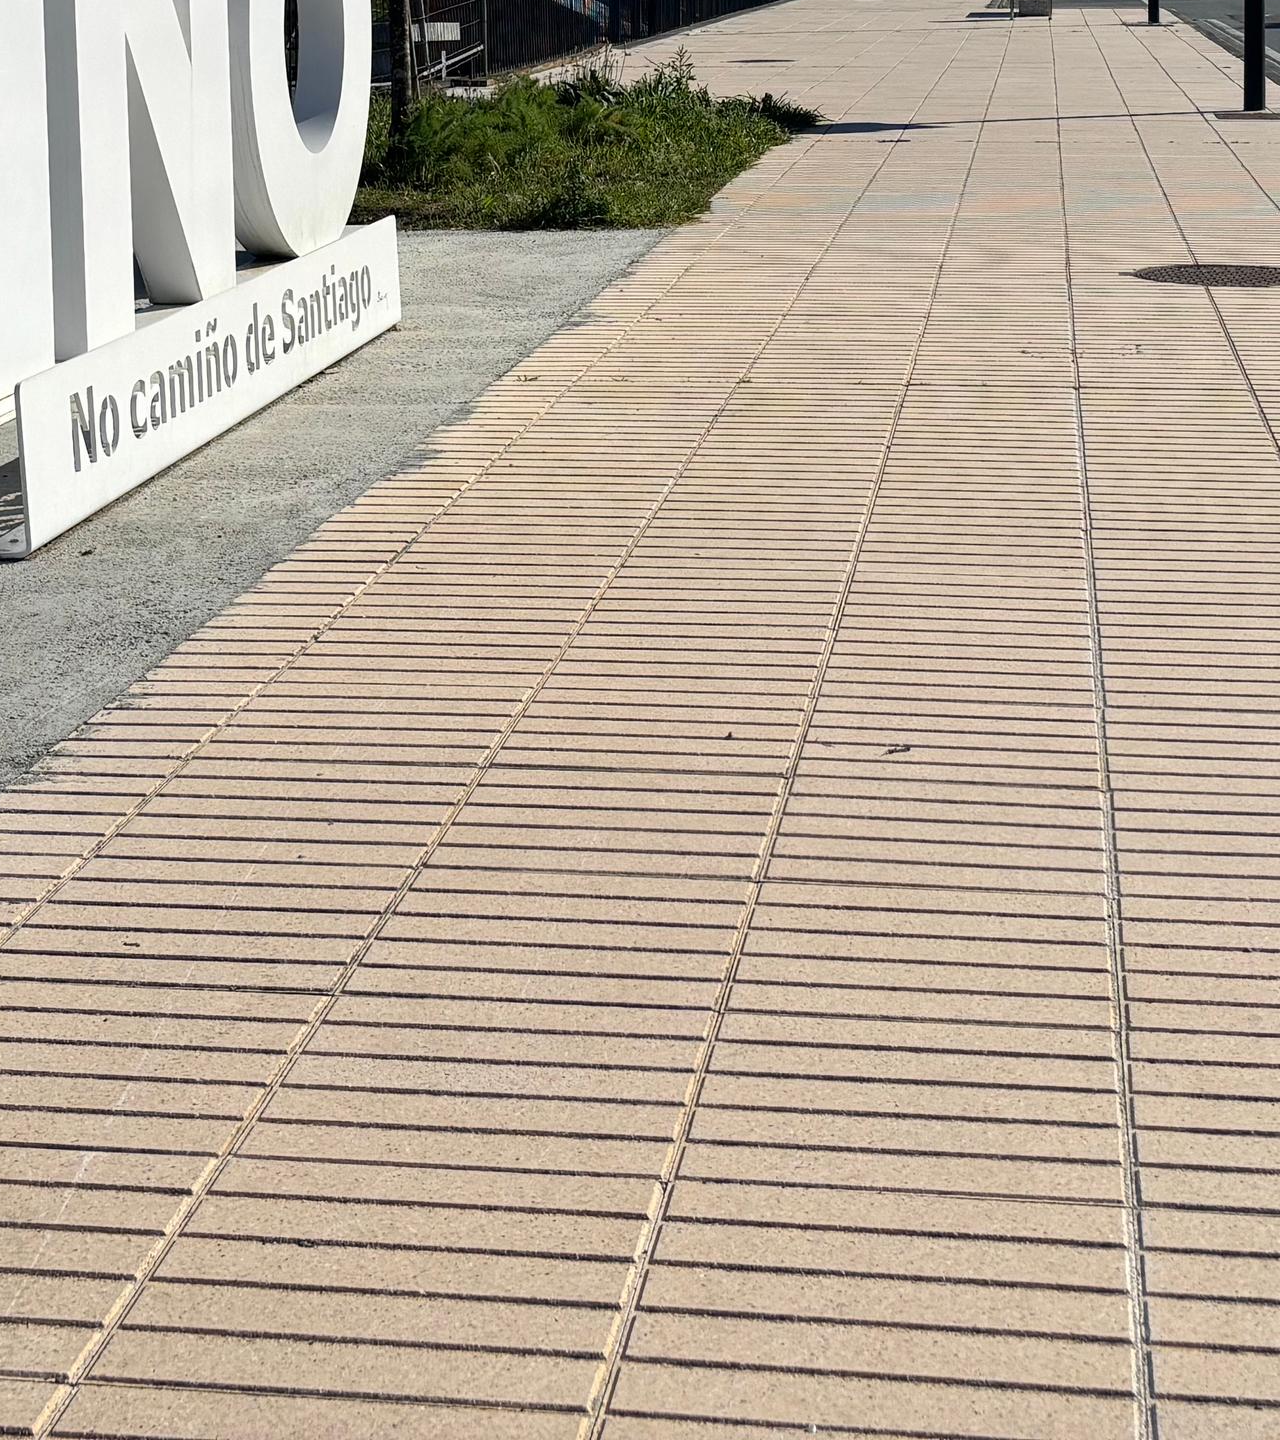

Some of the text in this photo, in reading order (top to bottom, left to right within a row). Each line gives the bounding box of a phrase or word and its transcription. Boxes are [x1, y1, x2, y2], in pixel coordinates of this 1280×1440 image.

[69, 264, 372, 472] No camiño de Santiago
